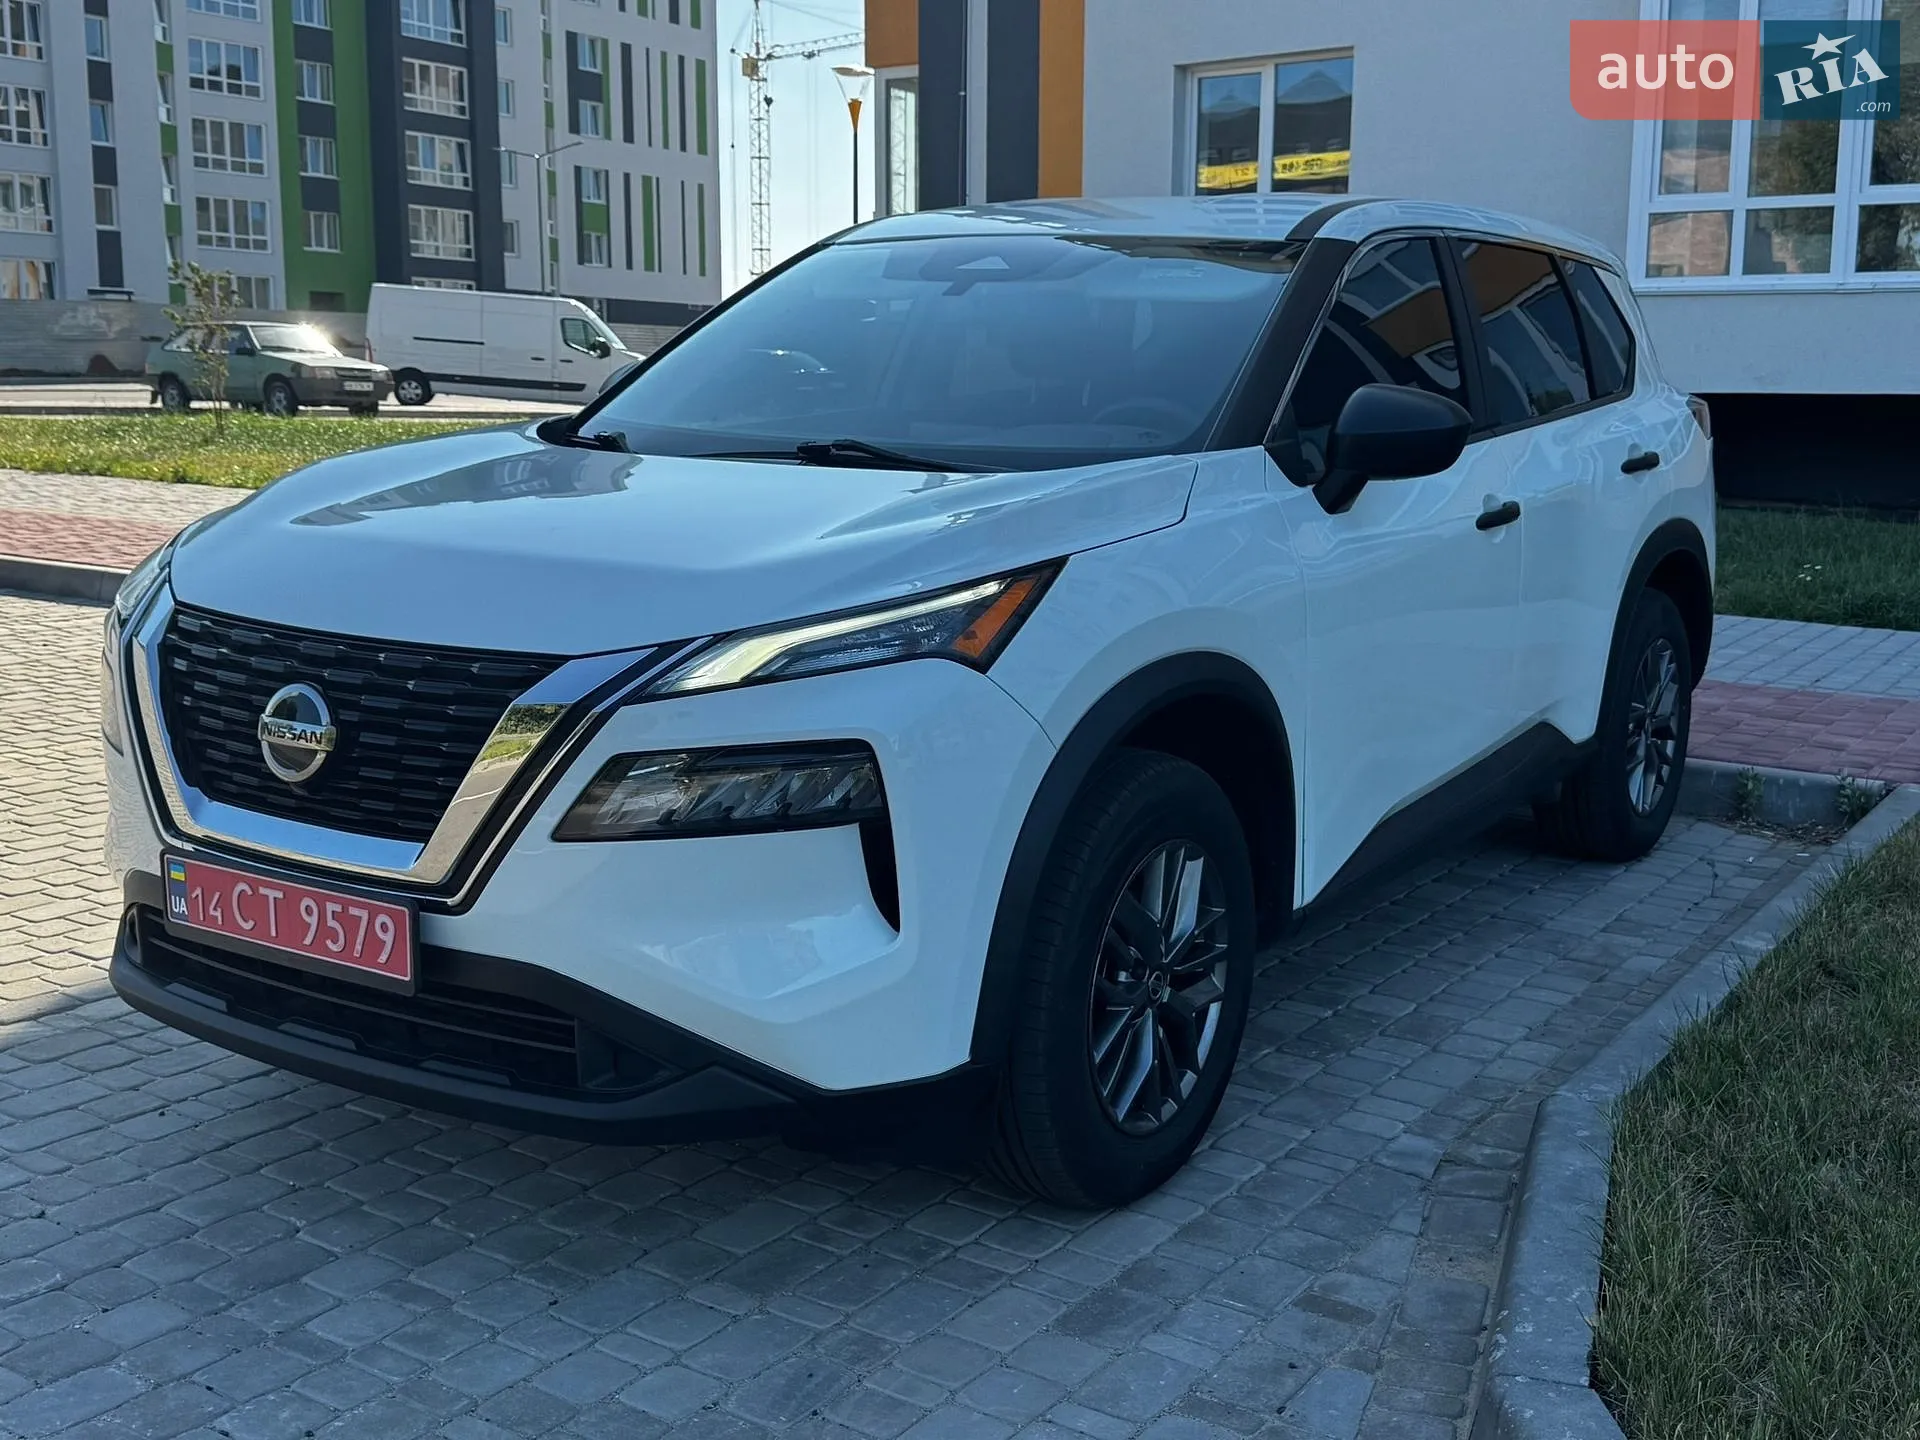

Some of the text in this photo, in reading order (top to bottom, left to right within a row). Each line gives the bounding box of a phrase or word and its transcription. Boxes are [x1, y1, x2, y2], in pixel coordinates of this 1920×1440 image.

[262, 720, 324, 745] NISSAN
[171, 895, 189, 916] UA
[299, 896, 396, 965] 9579
